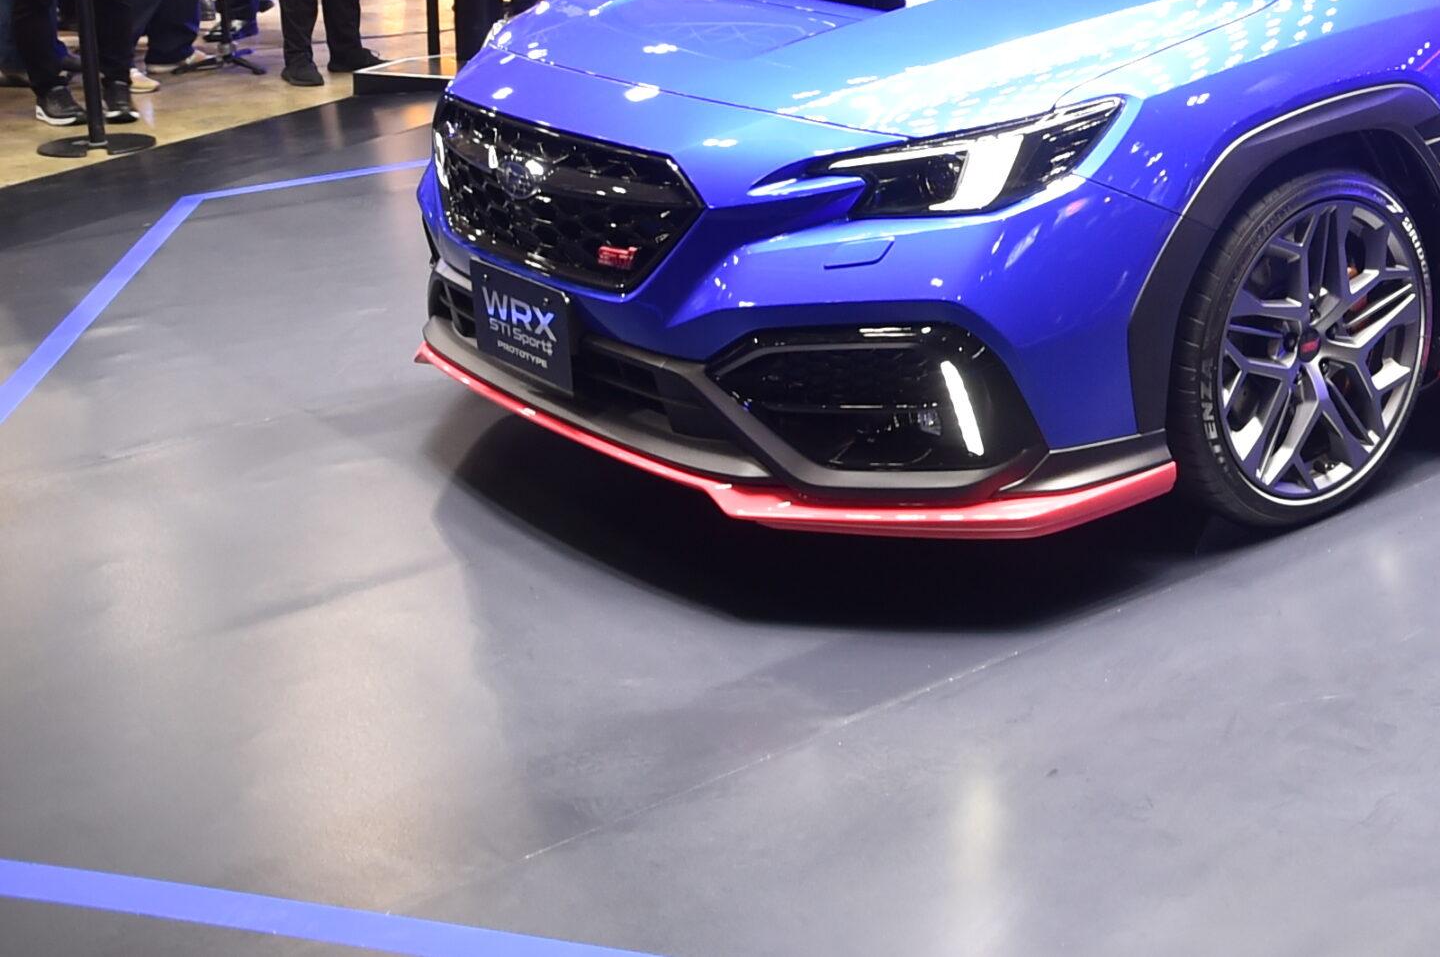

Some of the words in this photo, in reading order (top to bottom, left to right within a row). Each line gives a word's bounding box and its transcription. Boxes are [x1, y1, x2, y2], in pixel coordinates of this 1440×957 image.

[482, 286, 557, 342] WRX
[489, 317, 512, 337] STI
[497, 340, 548, 369] PROTOTYPE
